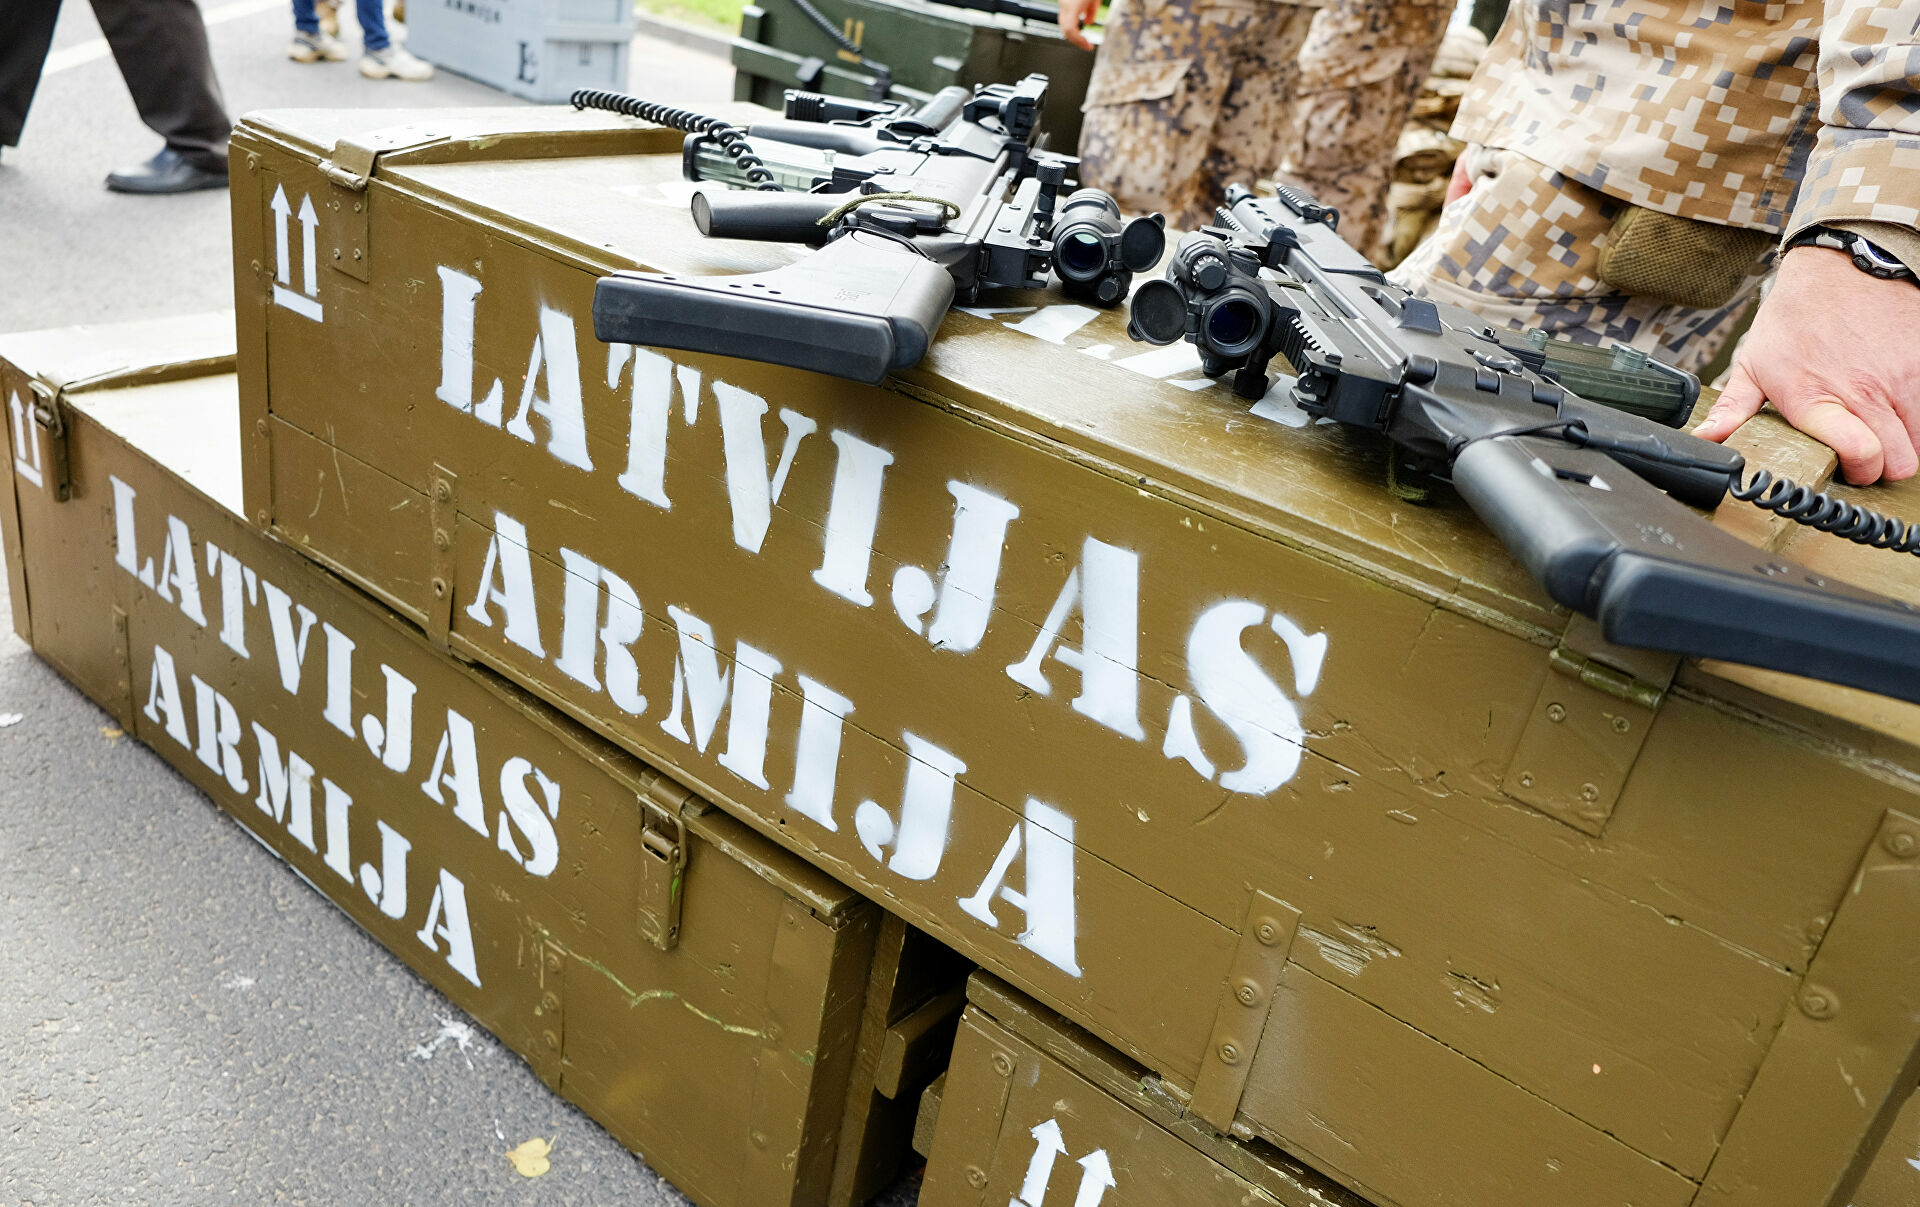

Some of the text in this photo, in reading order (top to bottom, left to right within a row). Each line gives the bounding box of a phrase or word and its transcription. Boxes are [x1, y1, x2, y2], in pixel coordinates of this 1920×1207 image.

[110, 475, 561, 877] LATVIJAS
[436, 265, 1328, 797] LATVIJAS
[466, 511, 1082, 978] ARMIJA
[143, 644, 482, 988] ARMIJA
